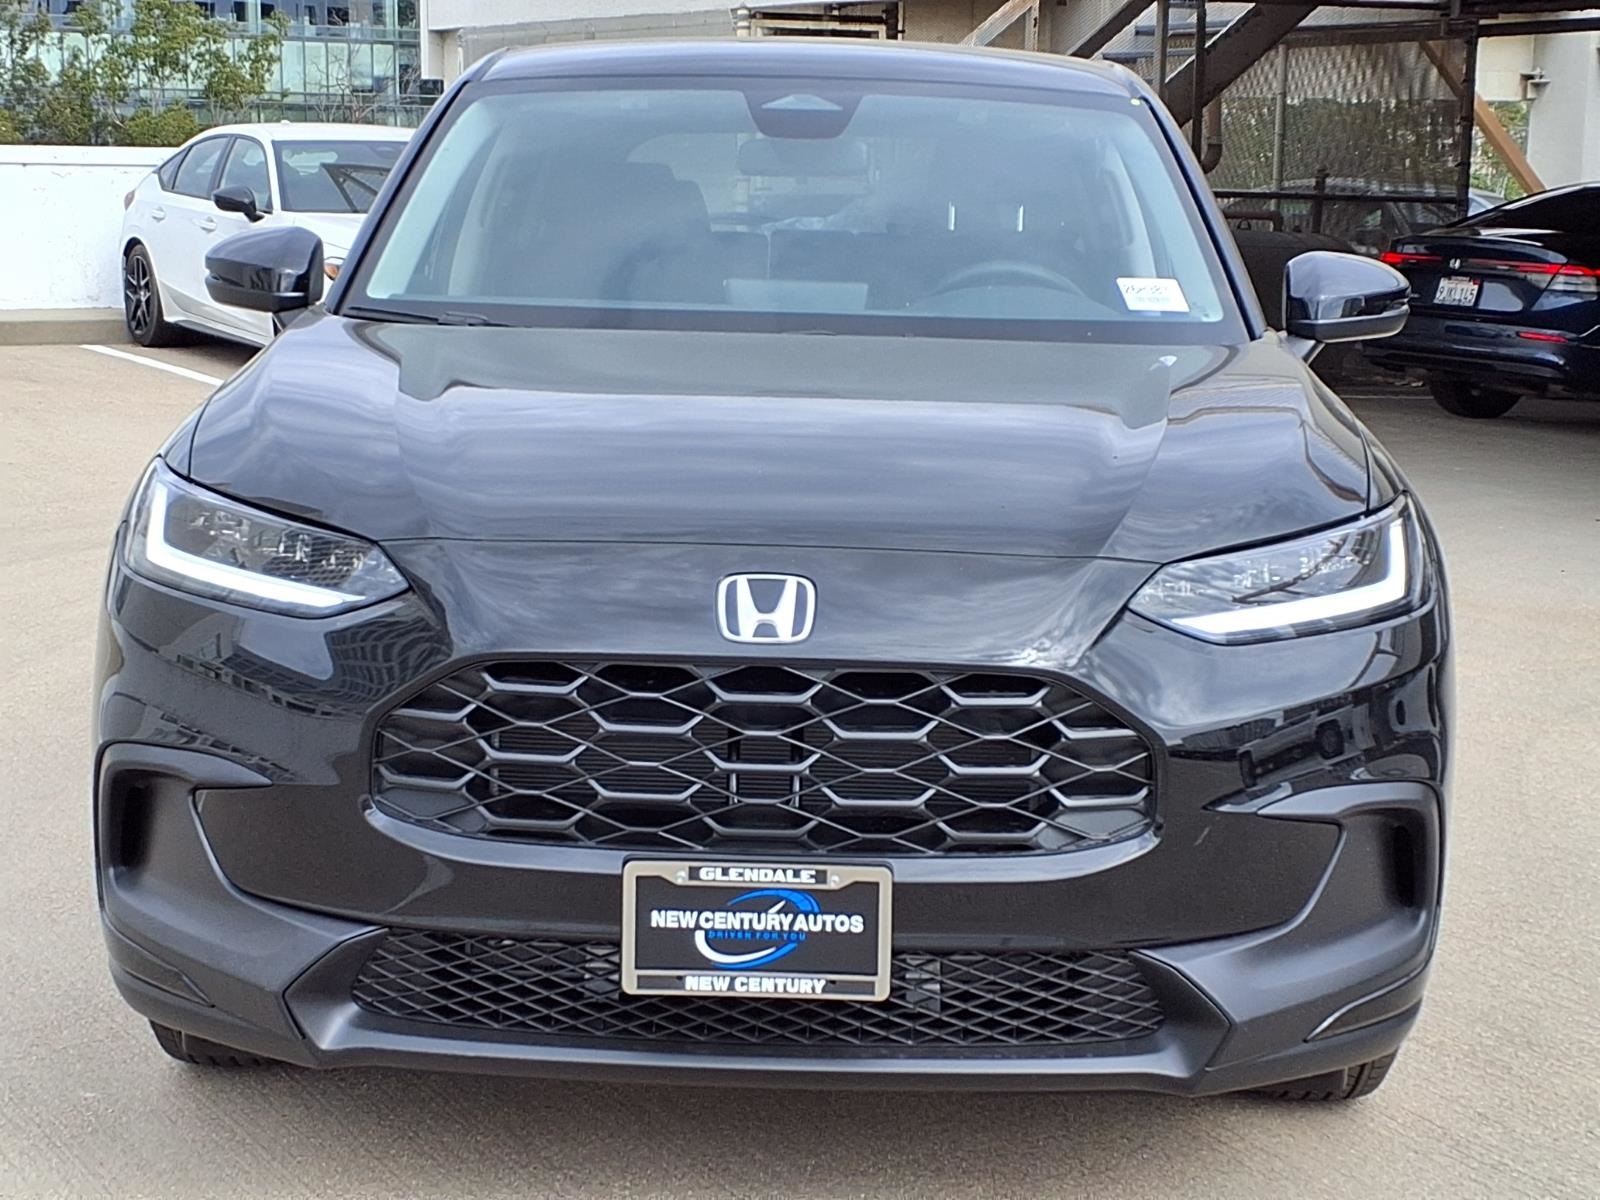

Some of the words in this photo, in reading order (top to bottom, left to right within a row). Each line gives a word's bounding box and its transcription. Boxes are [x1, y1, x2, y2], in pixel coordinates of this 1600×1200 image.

[699, 867, 816, 884] GLENDALE
[650, 910, 698, 928] NEW
[699, 911, 794, 932] CENTURY
[792, 915, 864, 934] AUTOS
[708, 931, 751, 940] DRIVEN
[755, 933, 779, 941] FOR
[782, 934, 806, 942] YOU
[685, 976, 730, 991] NEW
[734, 977, 826, 994] CENTURY
